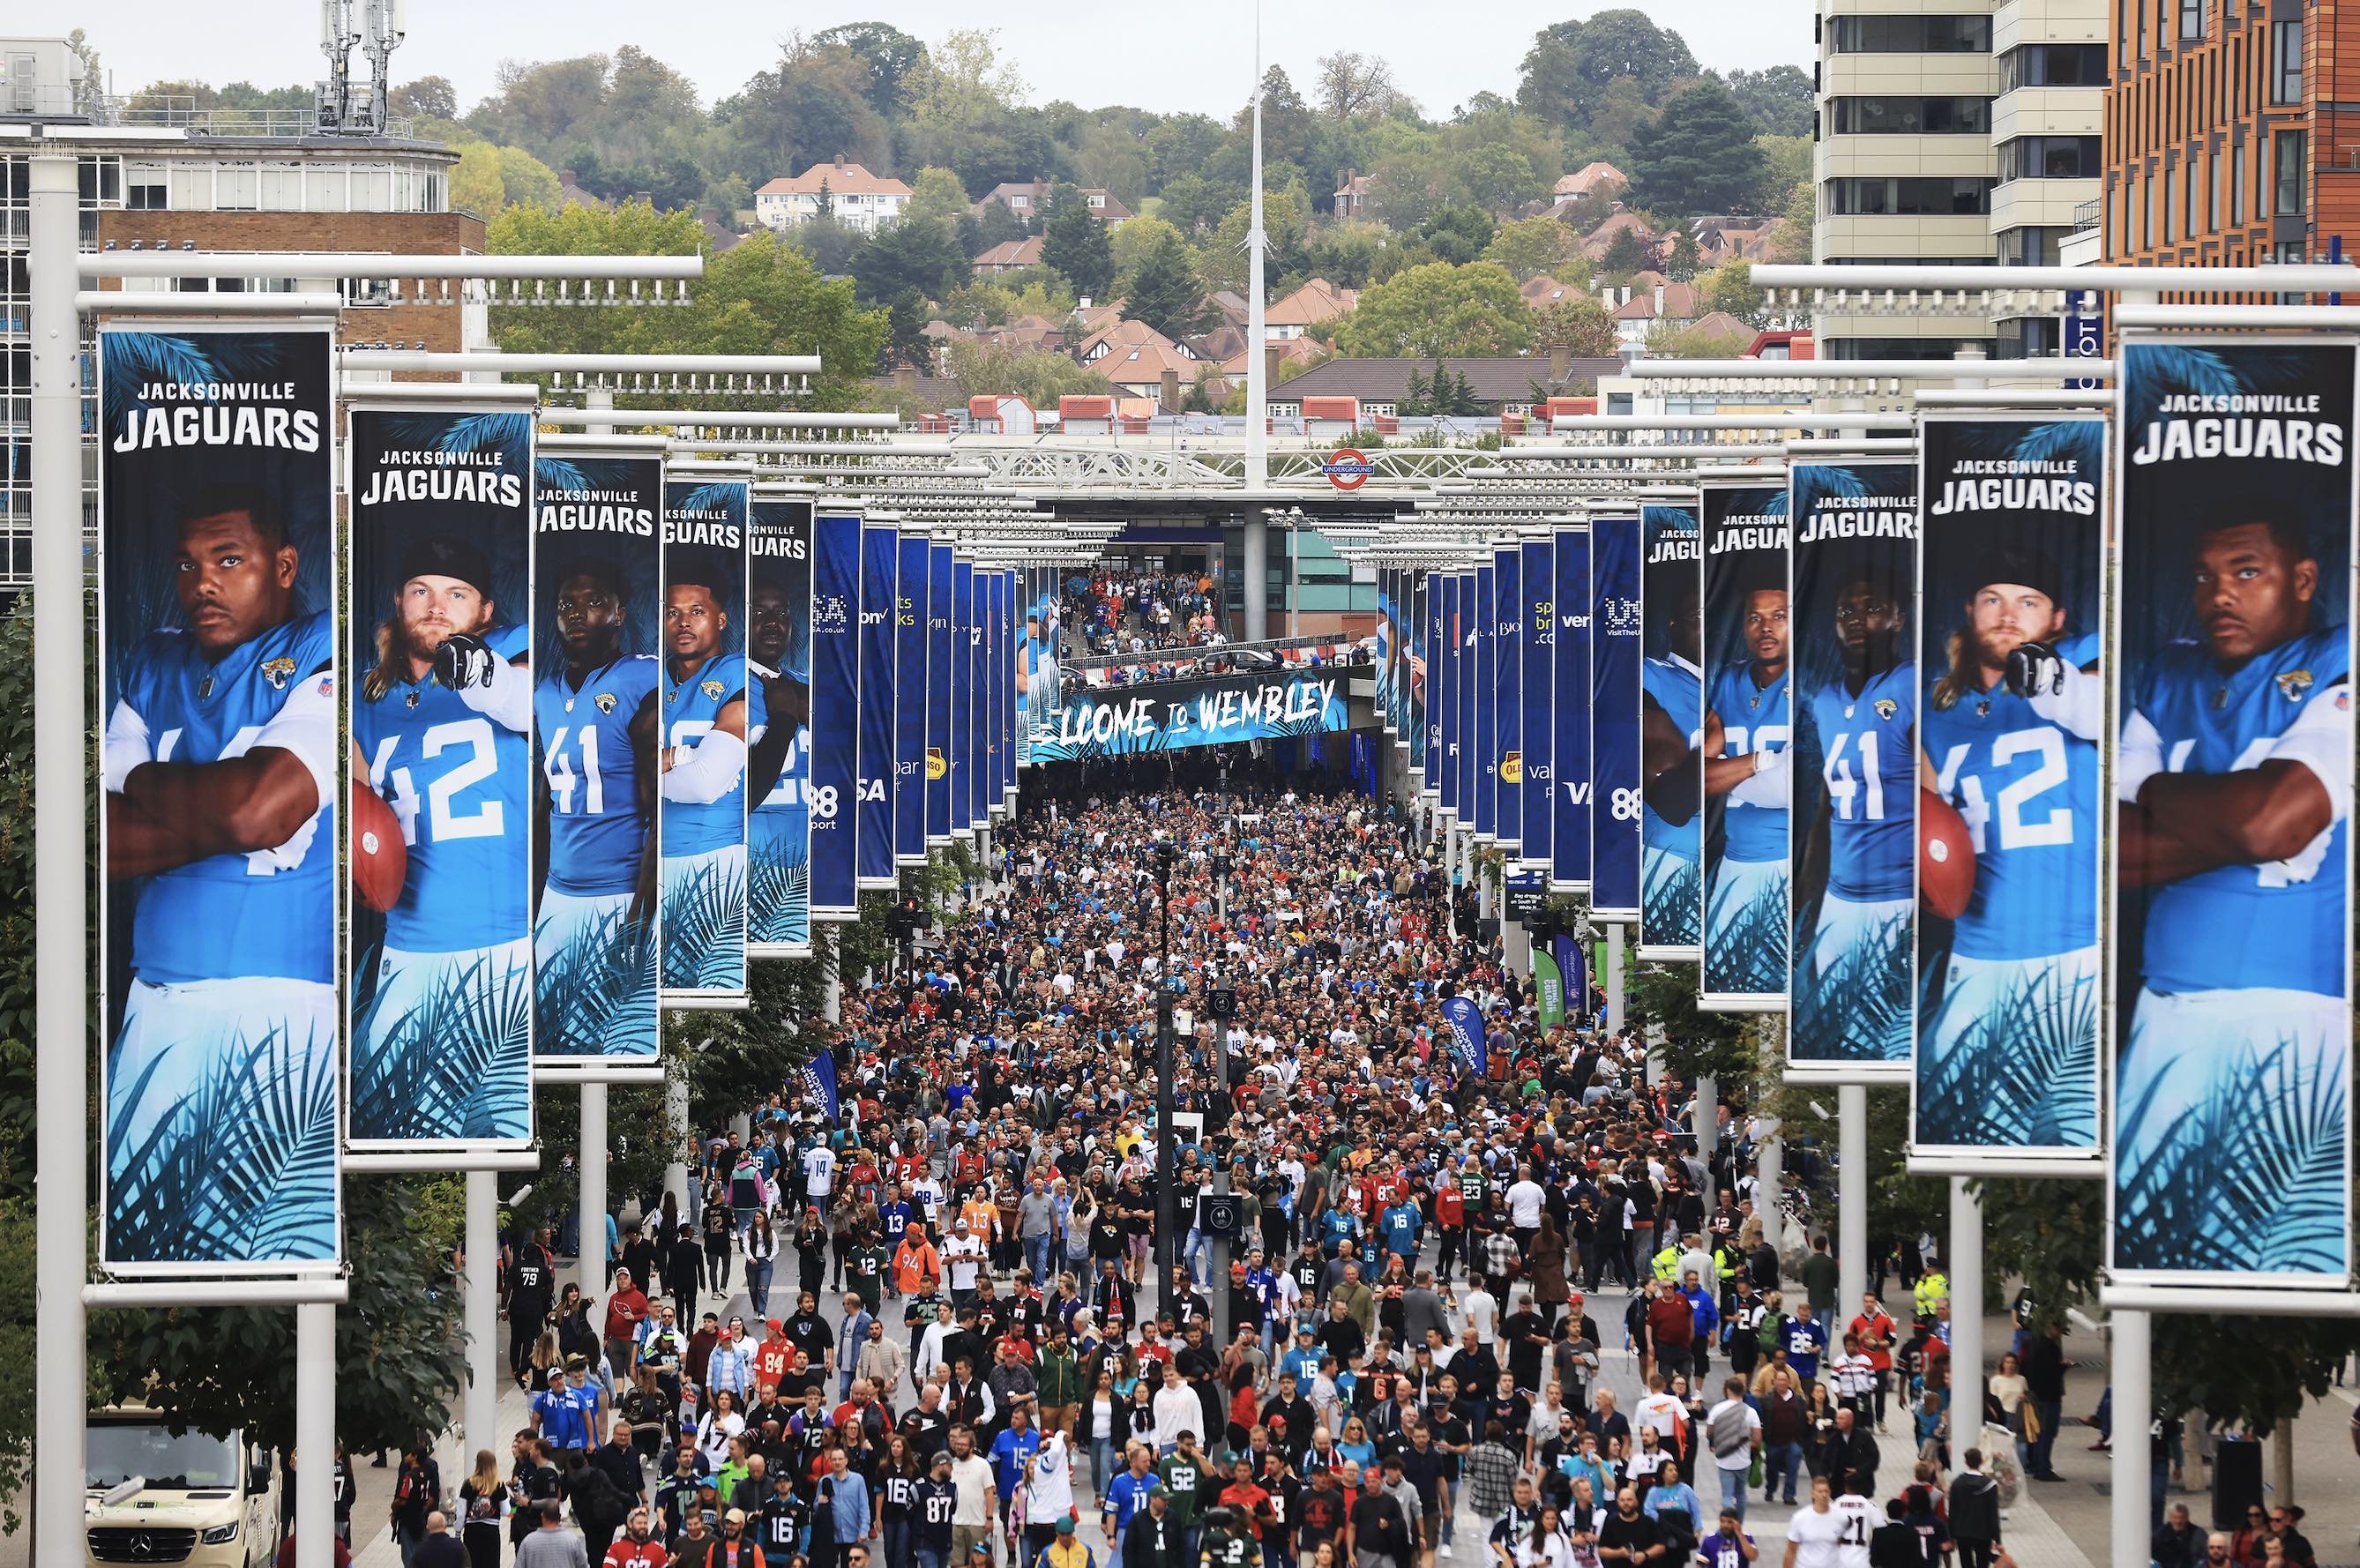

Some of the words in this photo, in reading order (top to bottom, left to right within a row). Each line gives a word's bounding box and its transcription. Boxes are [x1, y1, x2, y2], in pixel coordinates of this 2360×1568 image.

[138, 382, 295, 400] JACKSONVILLE
[2158, 393, 2320, 414] JACKSONVILLE
[114, 407, 319, 453] JAGUARS
[2132, 419, 2343, 467] JAGUARS
[379, 451, 503, 467] JACKSONVILLE
[1952, 459, 2077, 474] JACKSONVILLE
[361, 470, 521, 508] JAGUARS
[537, 489, 638, 503] JACKSONVILLE
[1931, 479, 2095, 516] JAGUARS
[1815, 496, 1917, 509] JACKSONVILLE
[1015, 574, 1024, 584] S
[1167, 703, 1188, 733] TO
[1199, 678, 1335, 734] WEMBLEY
[544, 723, 603, 814] 41
[1823, 730, 1885, 820] 41
[815, 1160, 826, 1177] 14
[901, 1165, 911, 1180] 2
[1463, 1185, 1481, 1200] 23
[710, 1216, 723, 1234] 12
[888, 1215, 903, 1233] 13
[972, 1212, 990, 1228] 13
[1335, 1221, 1348, 1232] 16
[1392, 1213, 1407, 1229] 16
[902, 1254, 919, 1272] 94
[1364, 1250, 1375, 1262] 16
[861, 1258, 877, 1275] 12
[523, 1273, 538, 1287] 79
[1299, 1268, 1315, 1285] 16
[917, 1303, 938, 1325] 25
[1181, 1303, 1192, 1324] 7
[765, 1352, 785, 1375] 84
[1299, 1360, 1319, 1379] 16
[1374, 1378, 1386, 1400] 6
[713, 1431, 728, 1452] 7
[803, 1428, 824, 1448] 72
[1012, 1446, 1029, 1470] 15
[1170, 1467, 1196, 1490] 52
[887, 1477, 908, 1504] 16
[927, 1497, 952, 1524] 87
[771, 1516, 794, 1543] 16
